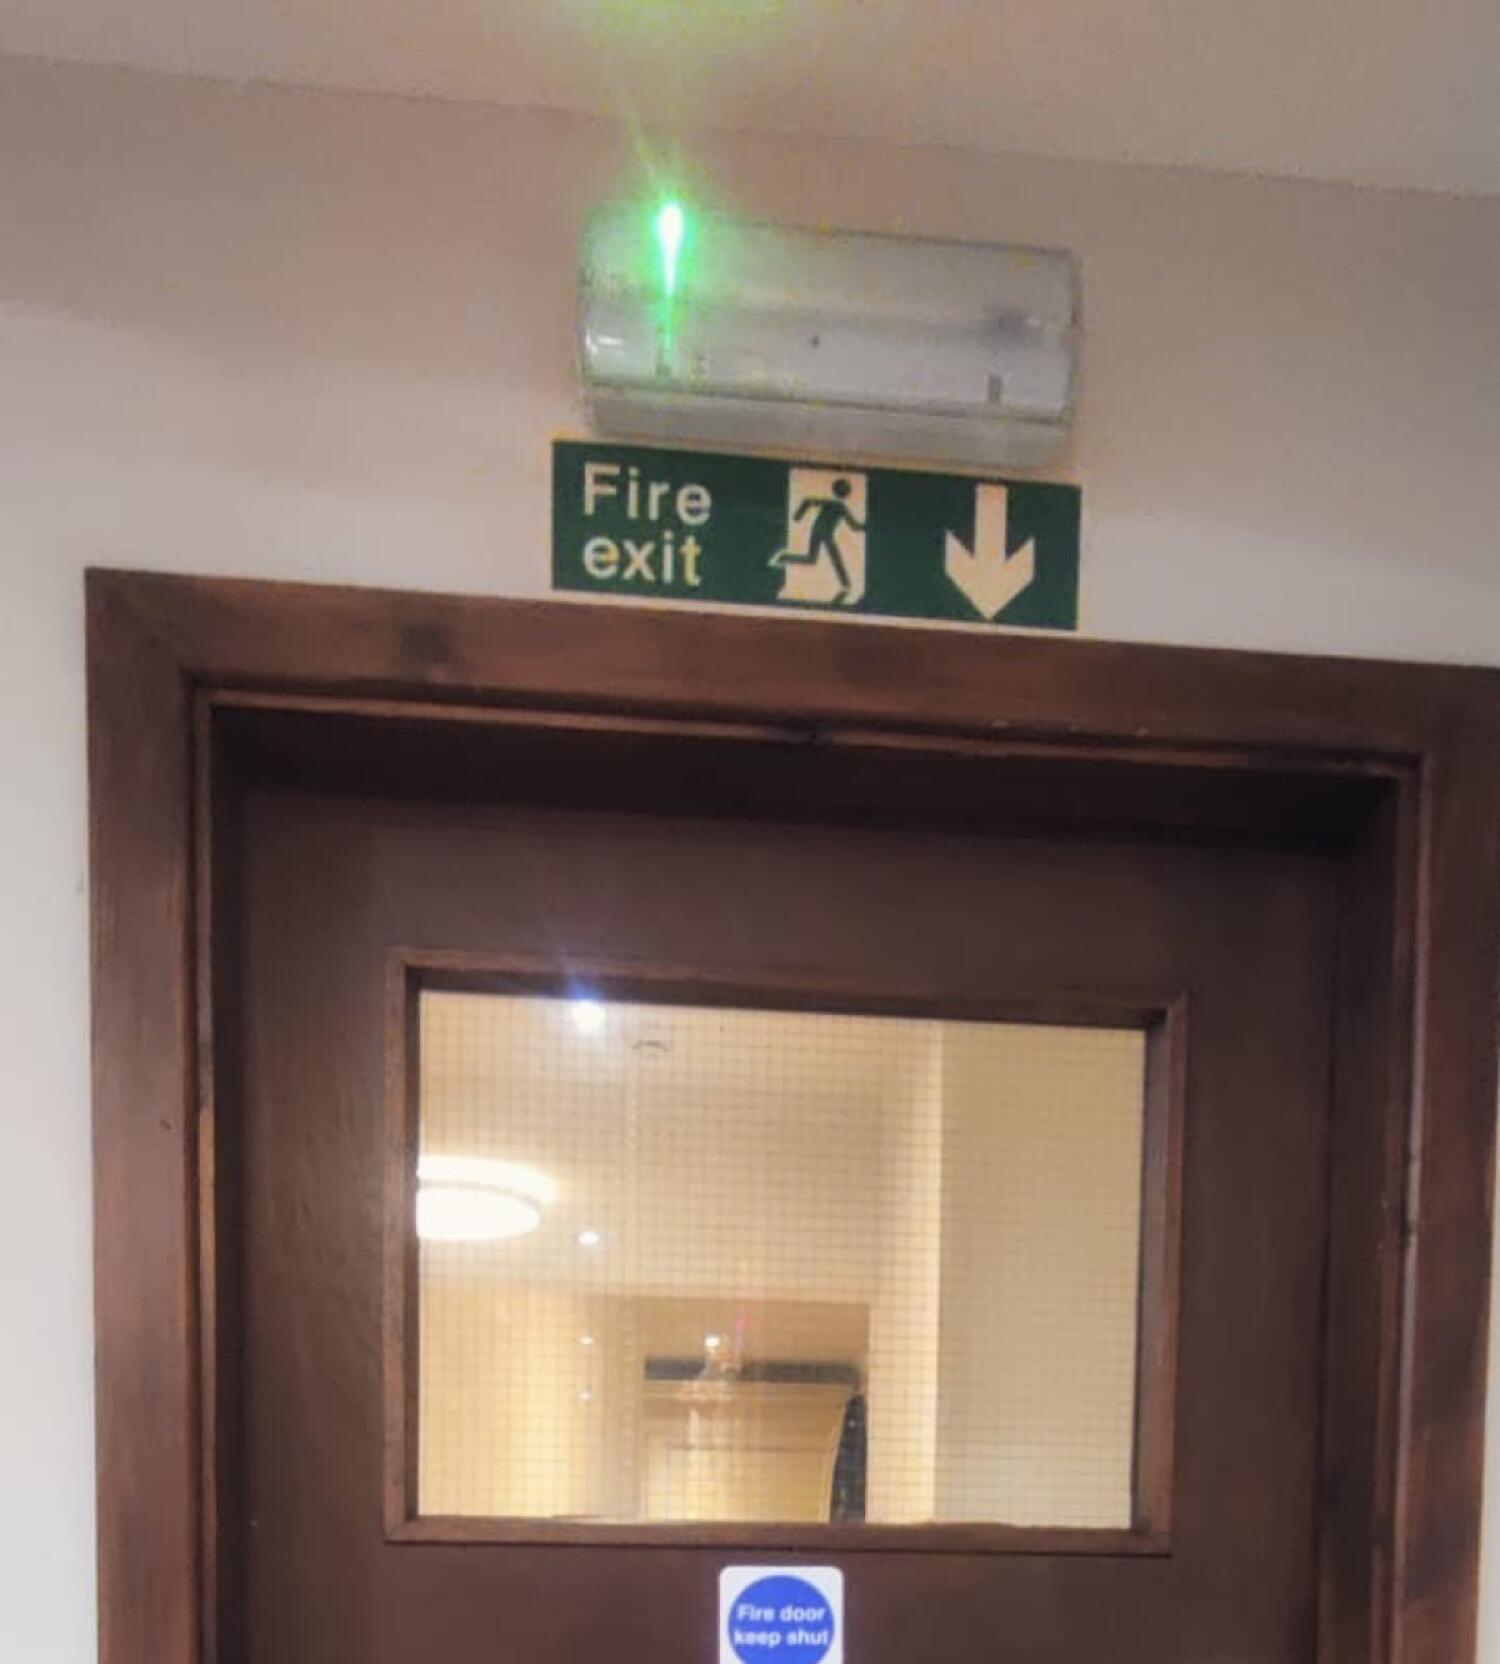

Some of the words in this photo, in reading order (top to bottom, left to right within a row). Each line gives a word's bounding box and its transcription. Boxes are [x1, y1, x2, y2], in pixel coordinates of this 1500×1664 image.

[583, 462, 712, 526] Fire
[583, 530, 703, 586] exit
[737, 1604, 775, 1621] Fire
[781, 1604, 825, 1622] door
[734, 1629, 780, 1648] keep
[786, 1628, 829, 1645] shut
